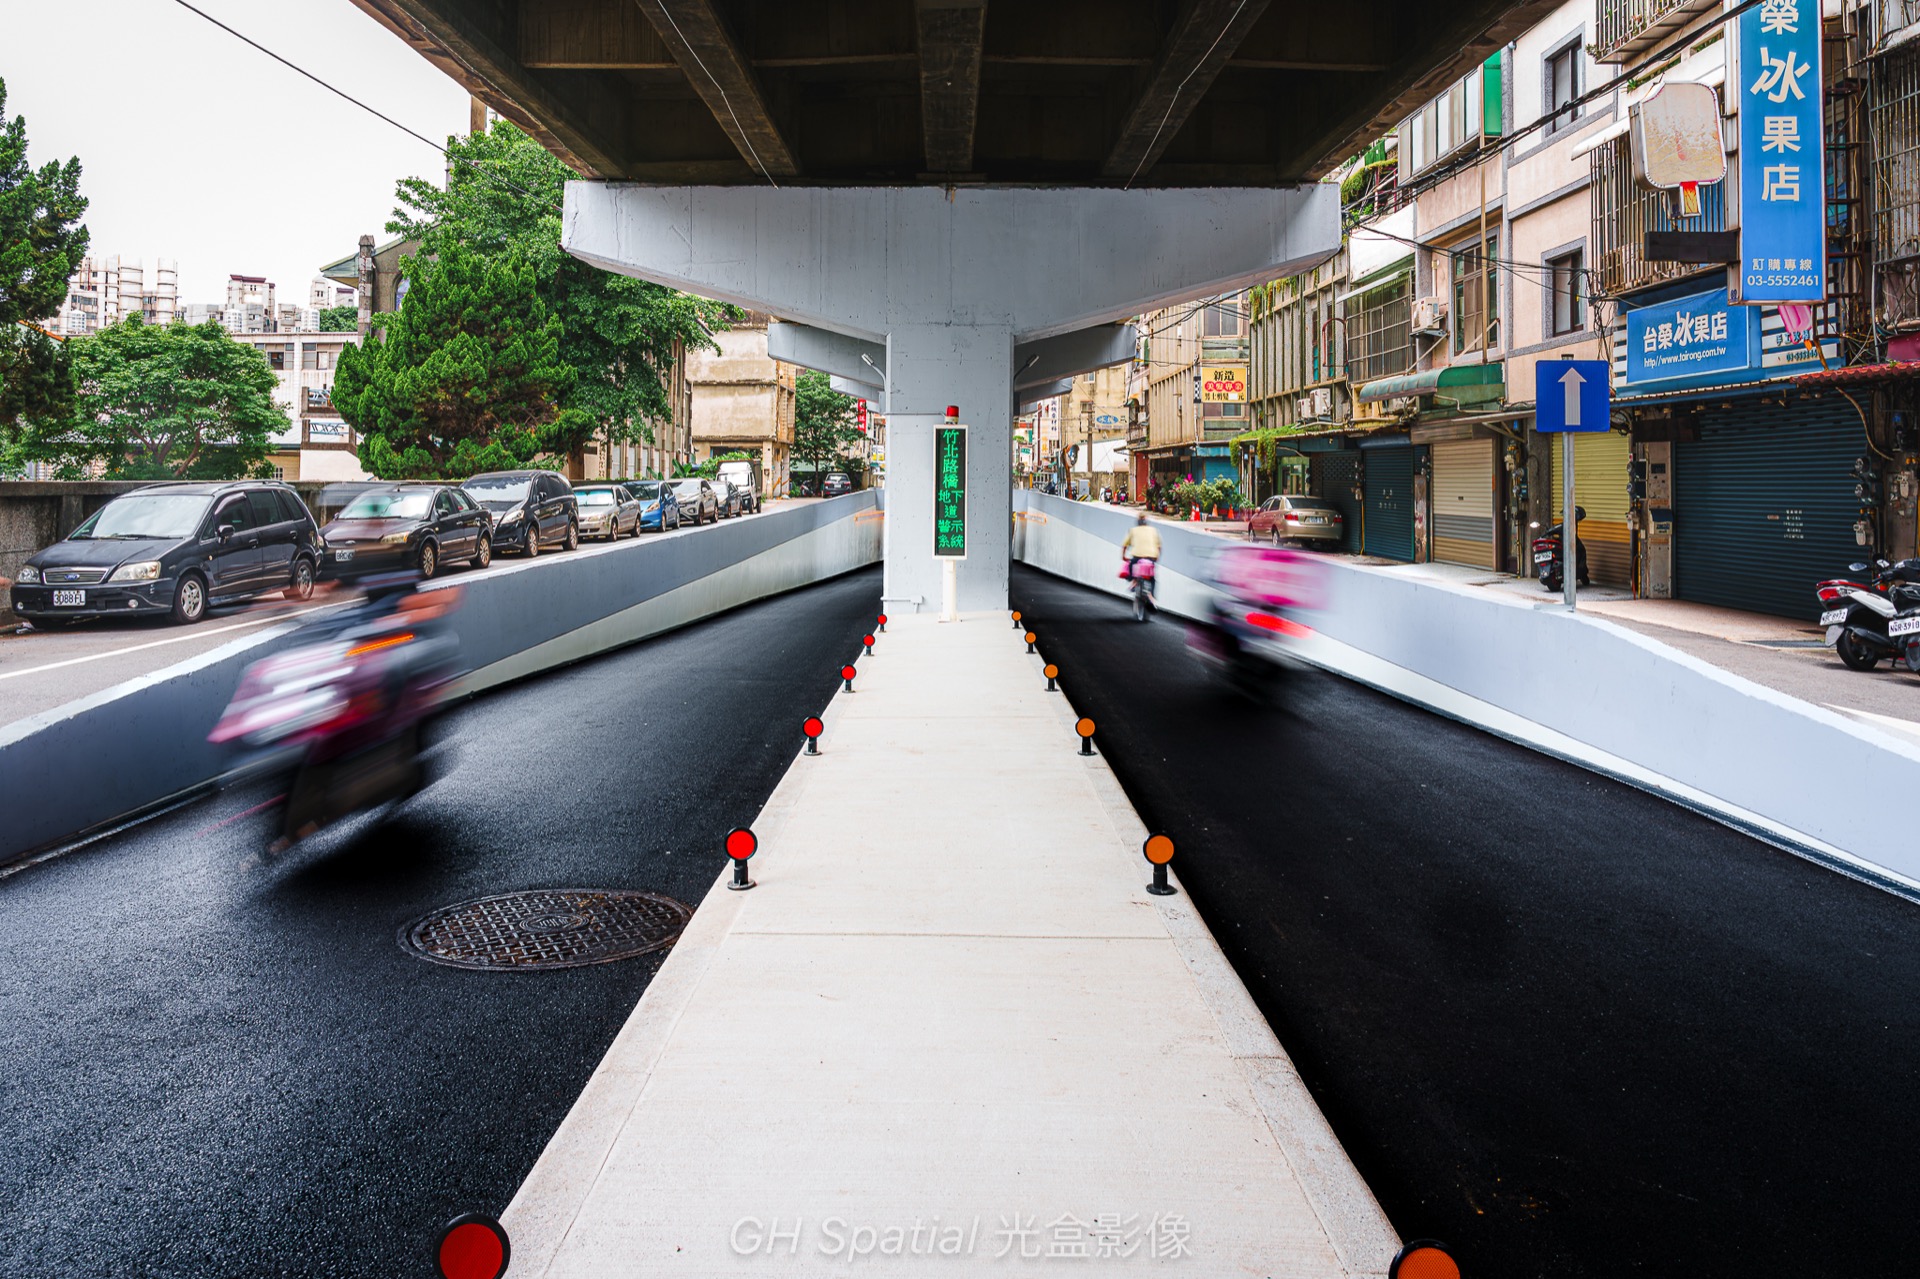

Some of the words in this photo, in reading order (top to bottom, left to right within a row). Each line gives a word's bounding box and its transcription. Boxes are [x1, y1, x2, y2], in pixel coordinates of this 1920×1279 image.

[1747, 275, 1819, 287] 03-5552461
[1643, 310, 1728, 353] 台榮冰果店
